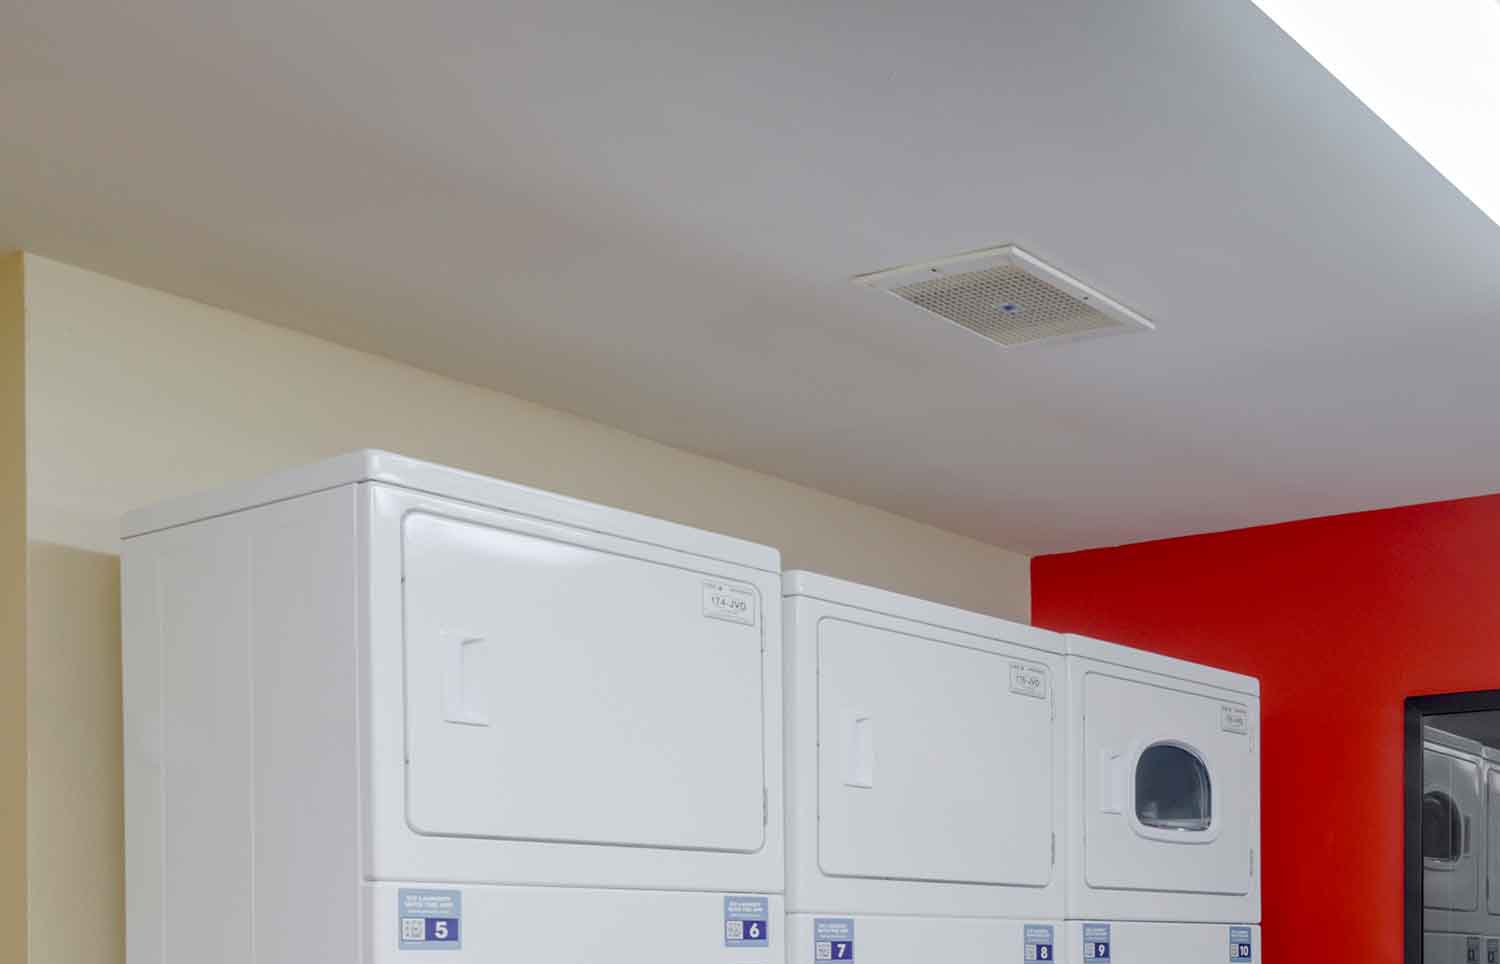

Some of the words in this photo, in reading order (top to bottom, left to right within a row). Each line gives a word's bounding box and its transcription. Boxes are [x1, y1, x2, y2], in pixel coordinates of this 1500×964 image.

[435, 921, 449, 939] 5
[749, 922, 760, 938] 6
[837, 943, 847, 958] 7
[1040, 946, 1049, 959] 8
[1098, 944, 1105, 957] 9
[1239, 946, 1249, 957] 10
